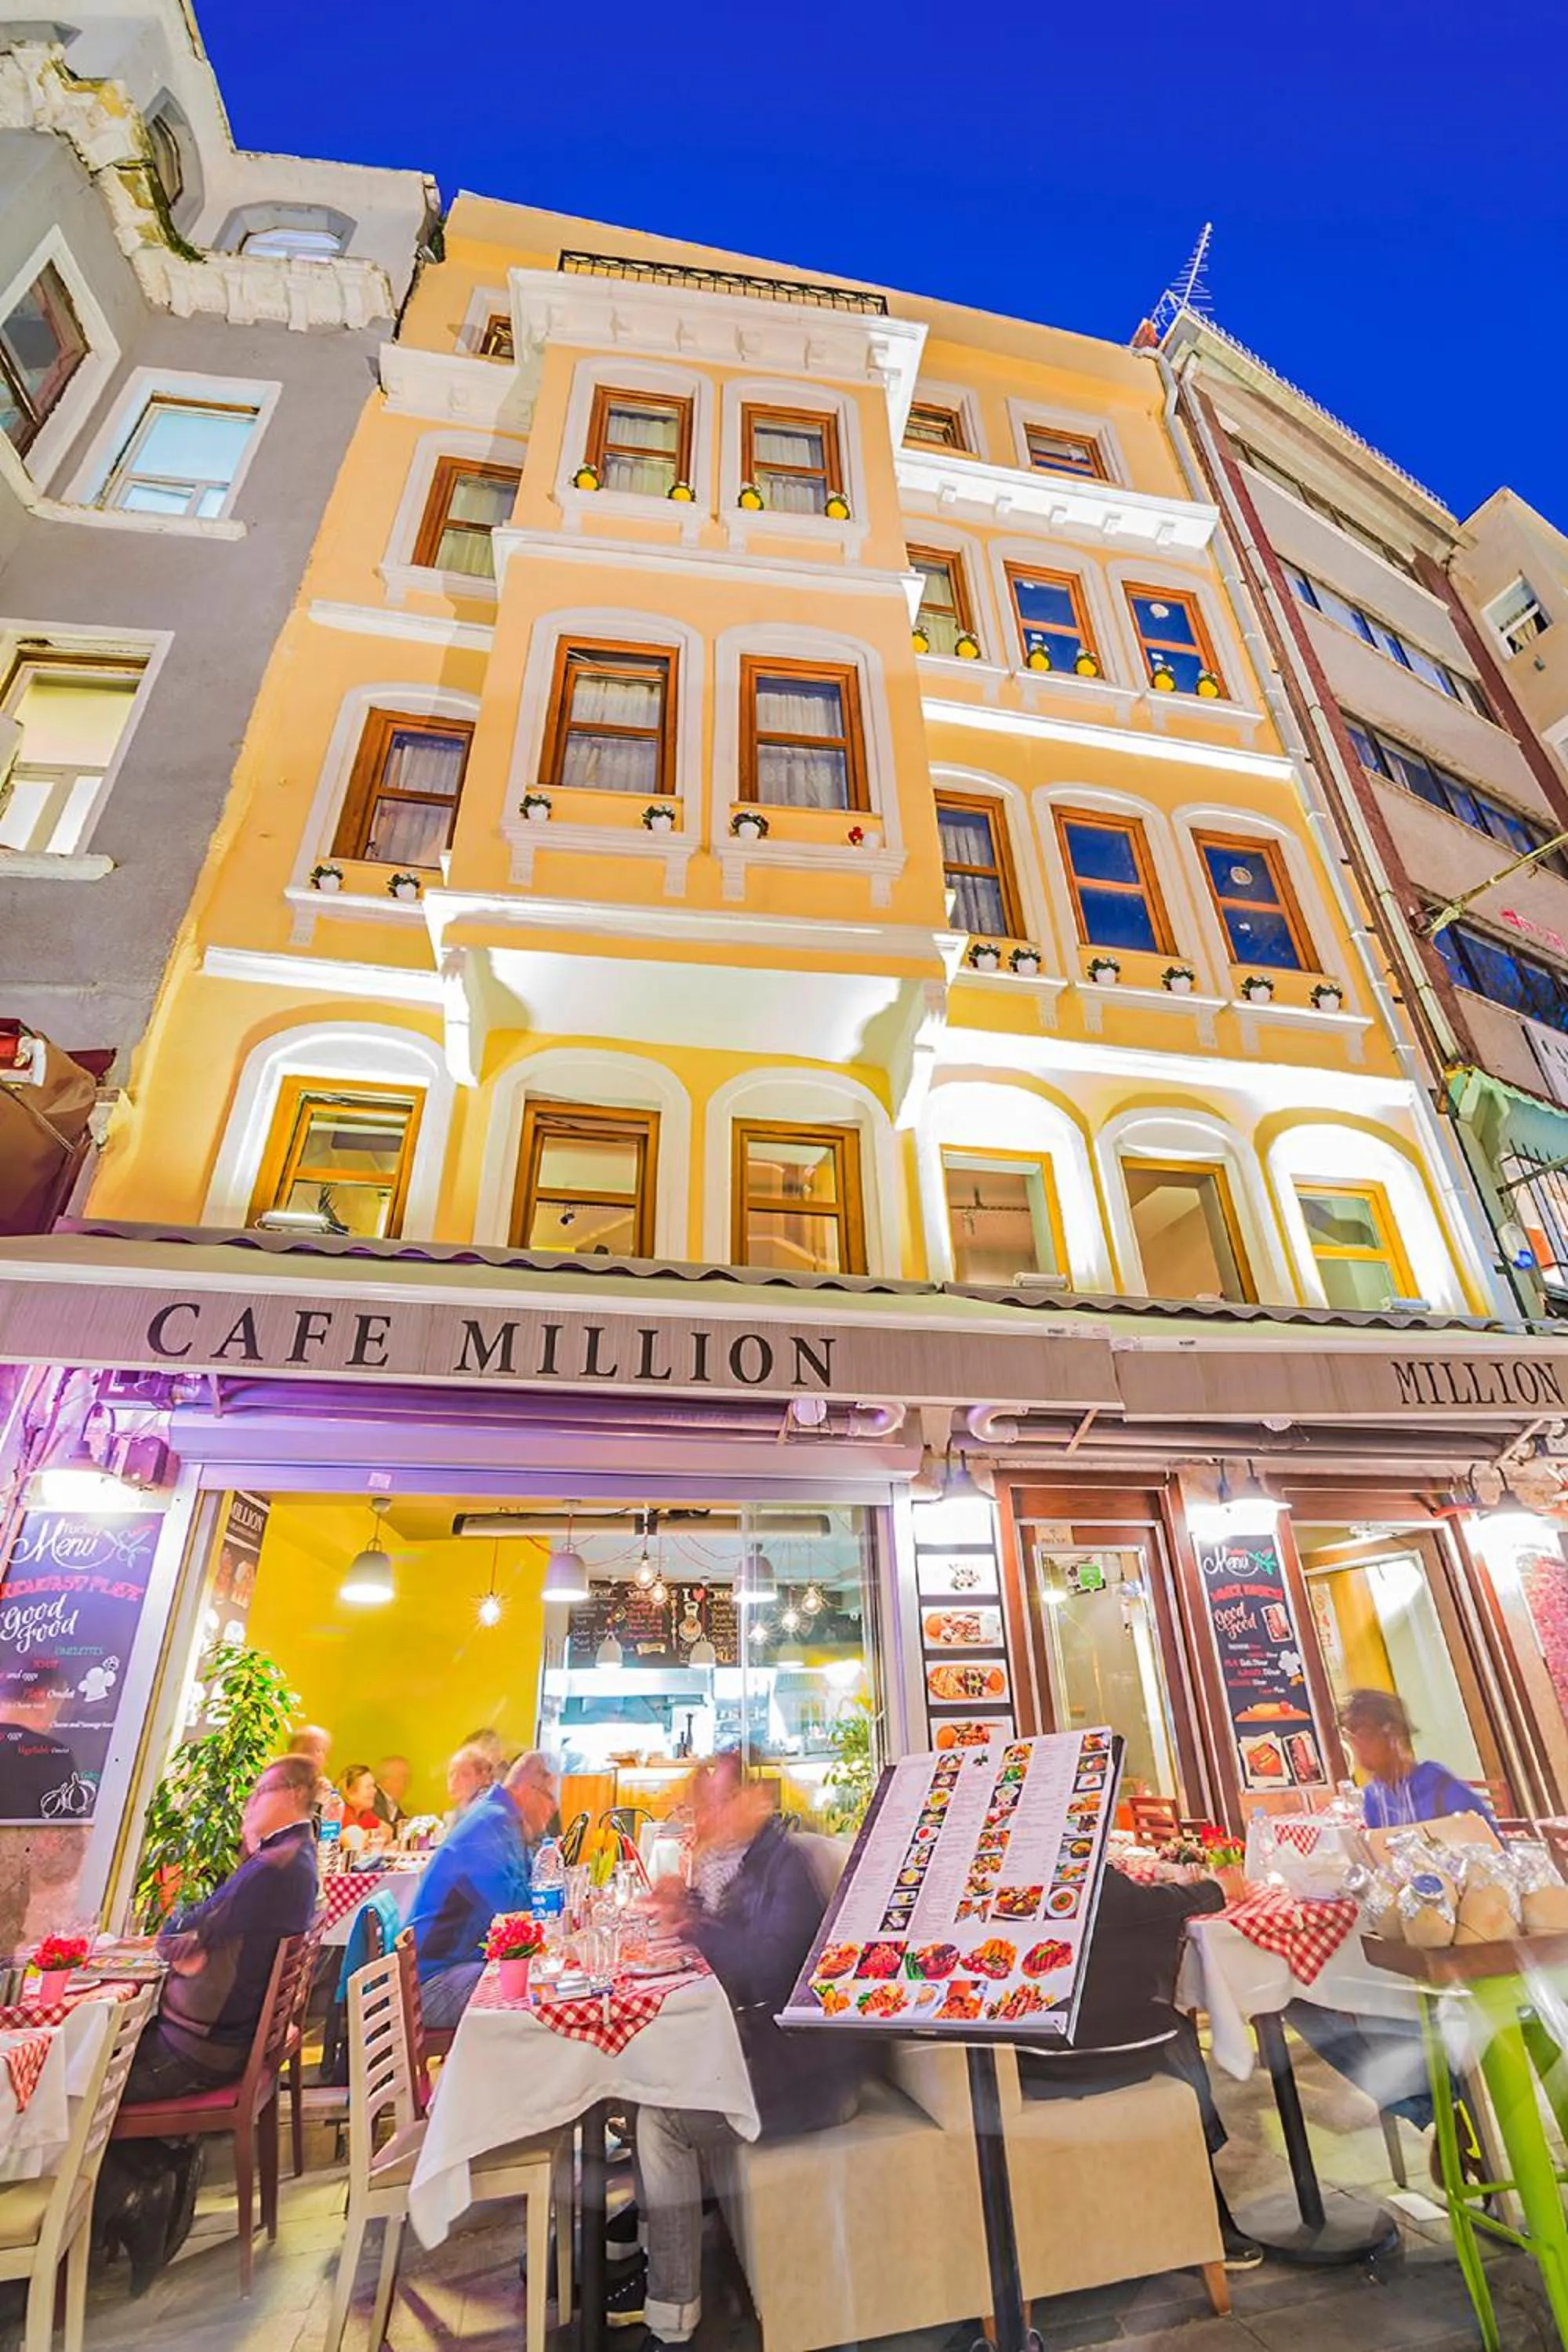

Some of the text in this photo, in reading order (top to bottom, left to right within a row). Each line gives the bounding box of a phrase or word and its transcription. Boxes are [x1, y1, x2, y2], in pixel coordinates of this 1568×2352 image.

[147, 1302, 837, 1388] CAFE MILLION
[1391, 1361, 1565, 1405] MILLION
[8, 1518, 99, 1569] Menu
[1203, 1545, 1249, 1575] Menu
